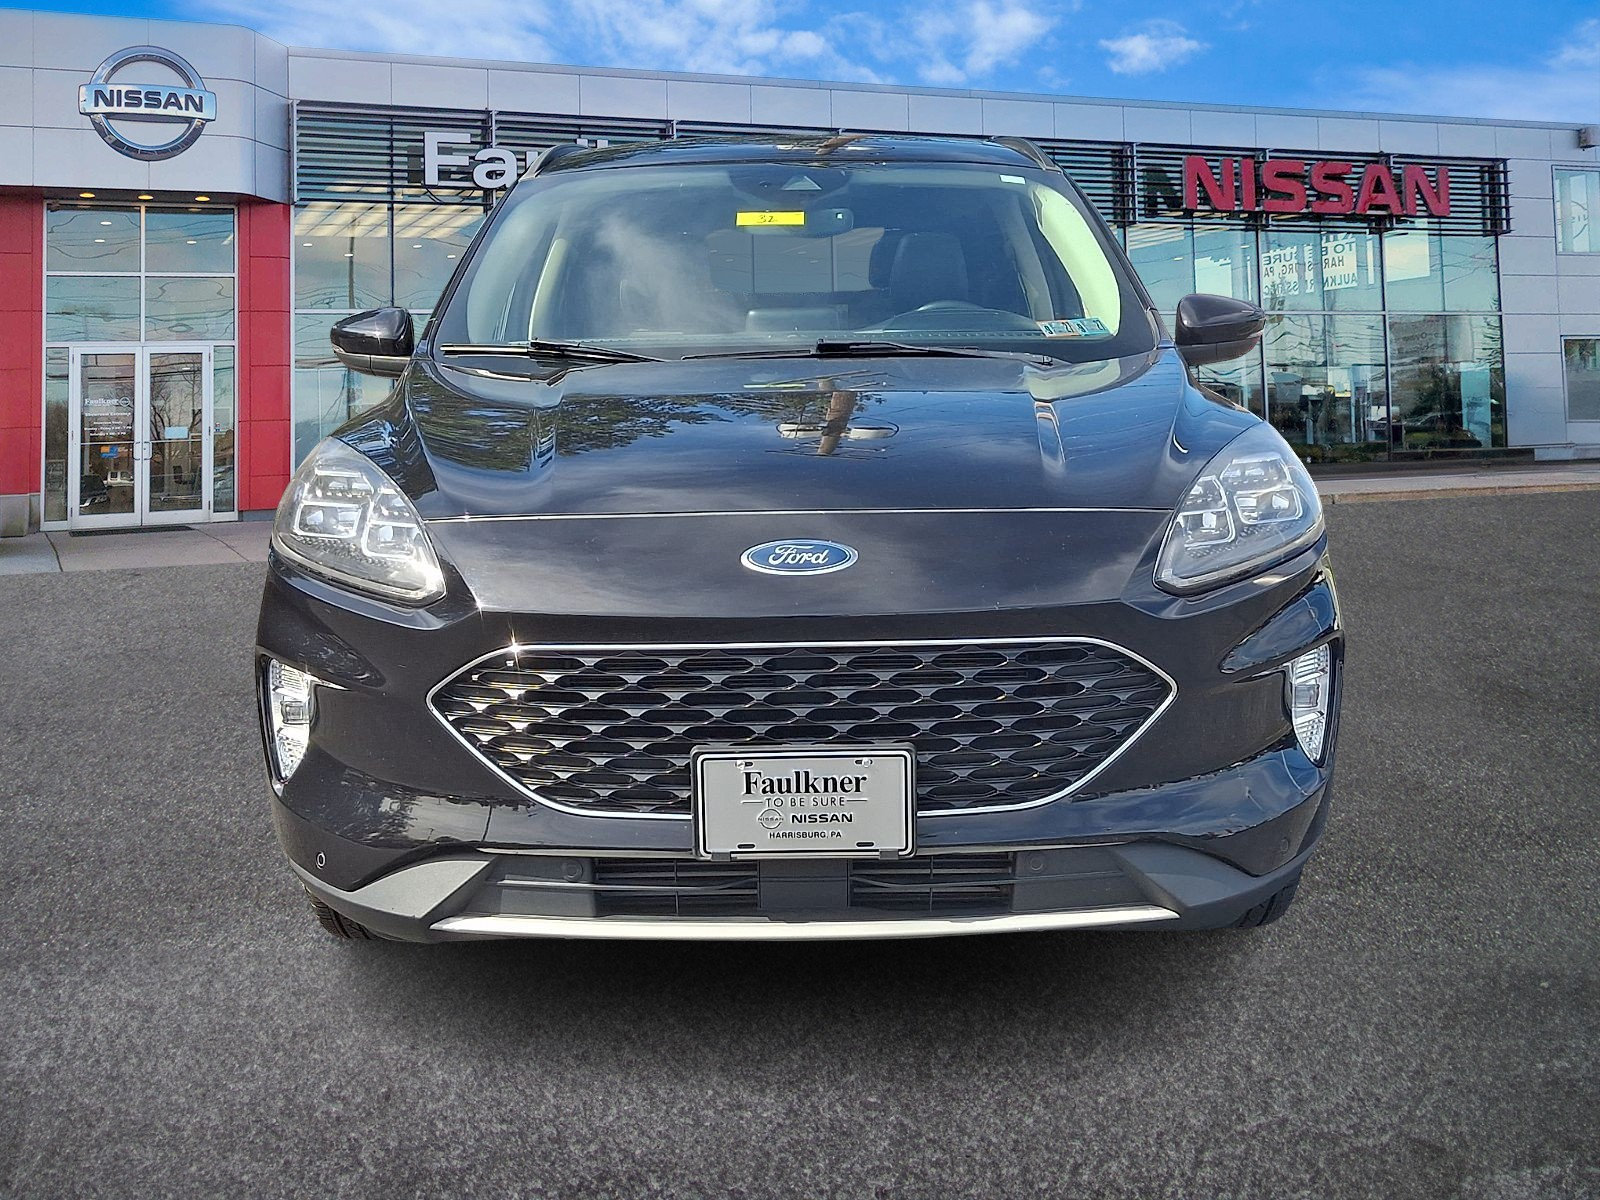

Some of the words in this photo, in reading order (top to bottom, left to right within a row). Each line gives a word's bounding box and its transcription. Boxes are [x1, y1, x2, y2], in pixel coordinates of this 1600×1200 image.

[93, 89, 204, 113] NISSAN
[1183, 155, 1450, 217] NISSAN
[768, 544, 830, 565] Ford
[742, 770, 867, 795] Faulkner
[765, 798, 784, 808] TO
[791, 797, 805, 807] BE
[813, 796, 846, 807] SURE
[791, 813, 853, 824] NISSAN
[769, 831, 828, 839] HARRISBURG,
[831, 831, 842, 839] PA
